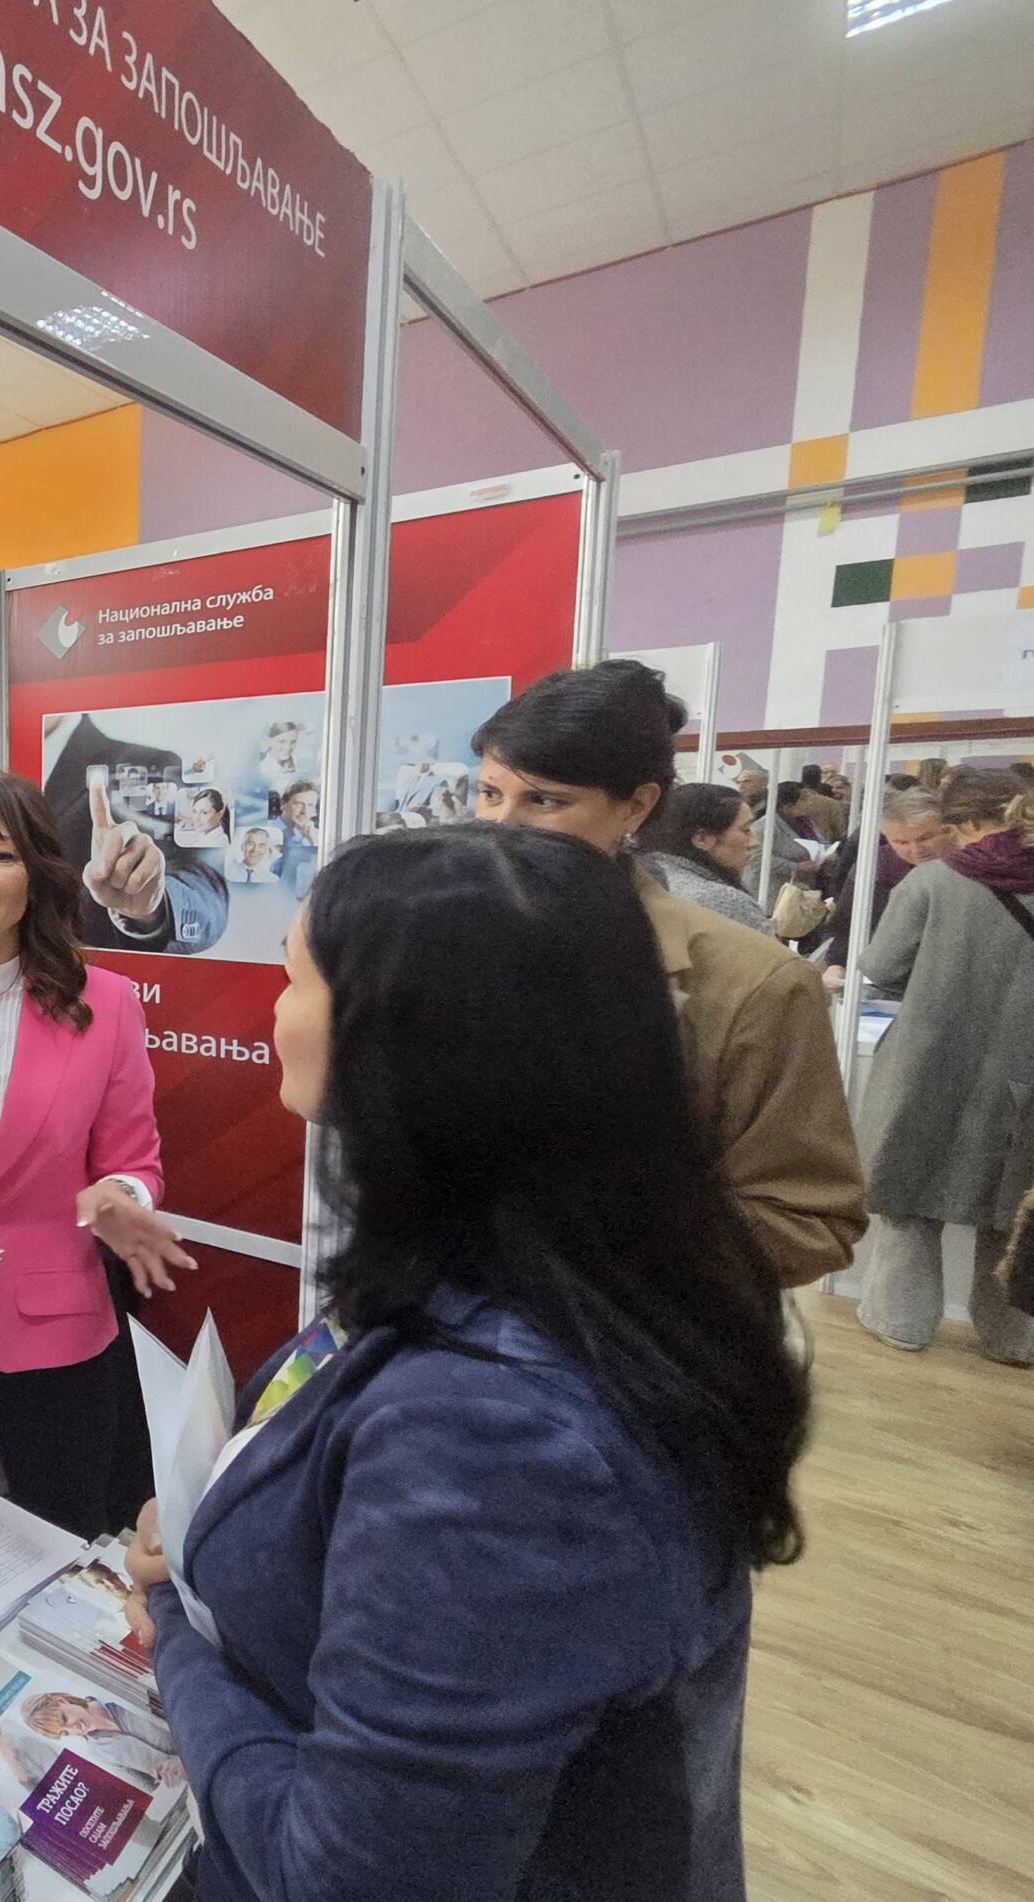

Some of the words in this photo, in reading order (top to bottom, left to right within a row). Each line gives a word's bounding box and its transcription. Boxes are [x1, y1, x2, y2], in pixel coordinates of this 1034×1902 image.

[69, 0, 113, 73] ЗА
[120, 31, 326, 258] ЗАПОШЉАВАЊЕ
[98, 597, 202, 624] Национална
[205, 584, 274, 611] служба
[97, 631, 115, 646] за
[117, 614, 245, 644] запошљавање
[36, 1764, 79, 1814] ТРАЖИТЕ
[54, 1781, 90, 1826] ПОСАО?
